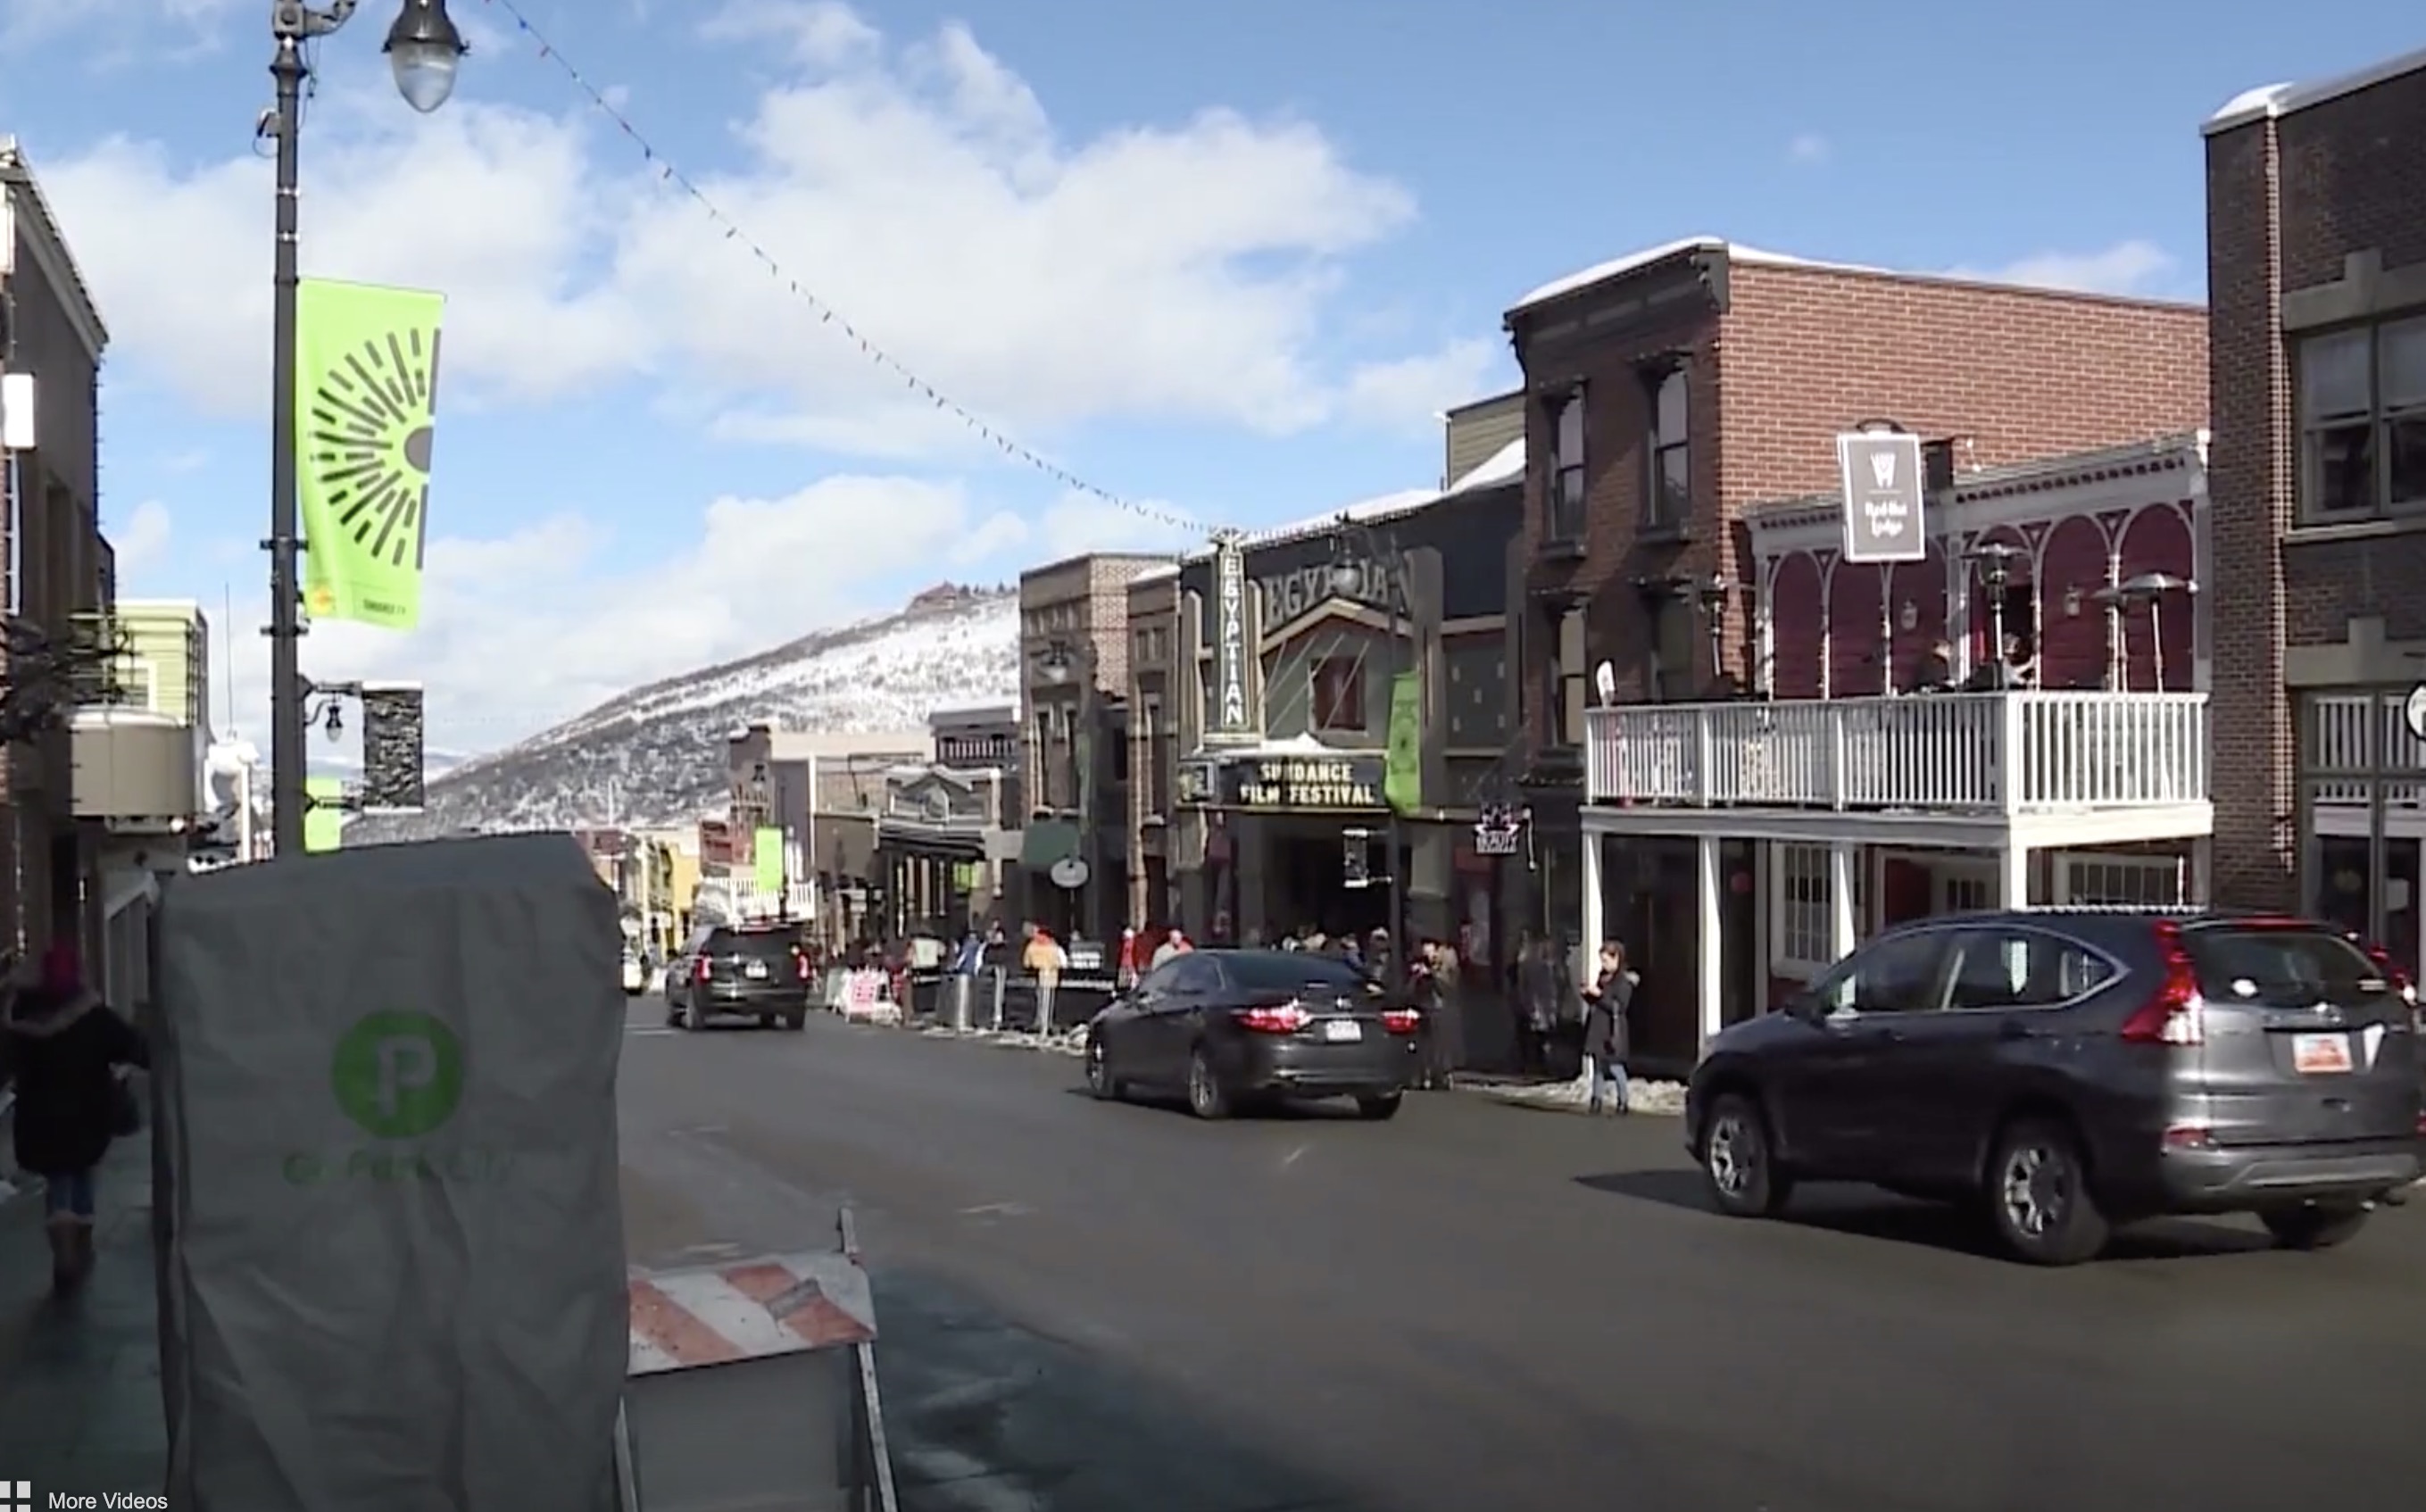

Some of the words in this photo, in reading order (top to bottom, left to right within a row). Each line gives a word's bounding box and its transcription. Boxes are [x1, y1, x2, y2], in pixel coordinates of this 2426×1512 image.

[1263, 557, 1416, 630] EGYPIAN
[1225, 556, 1243, 726] EGYPTIAN
[1240, 785, 1281, 803] FILM
[1289, 785, 1375, 804] FESTIVAL
